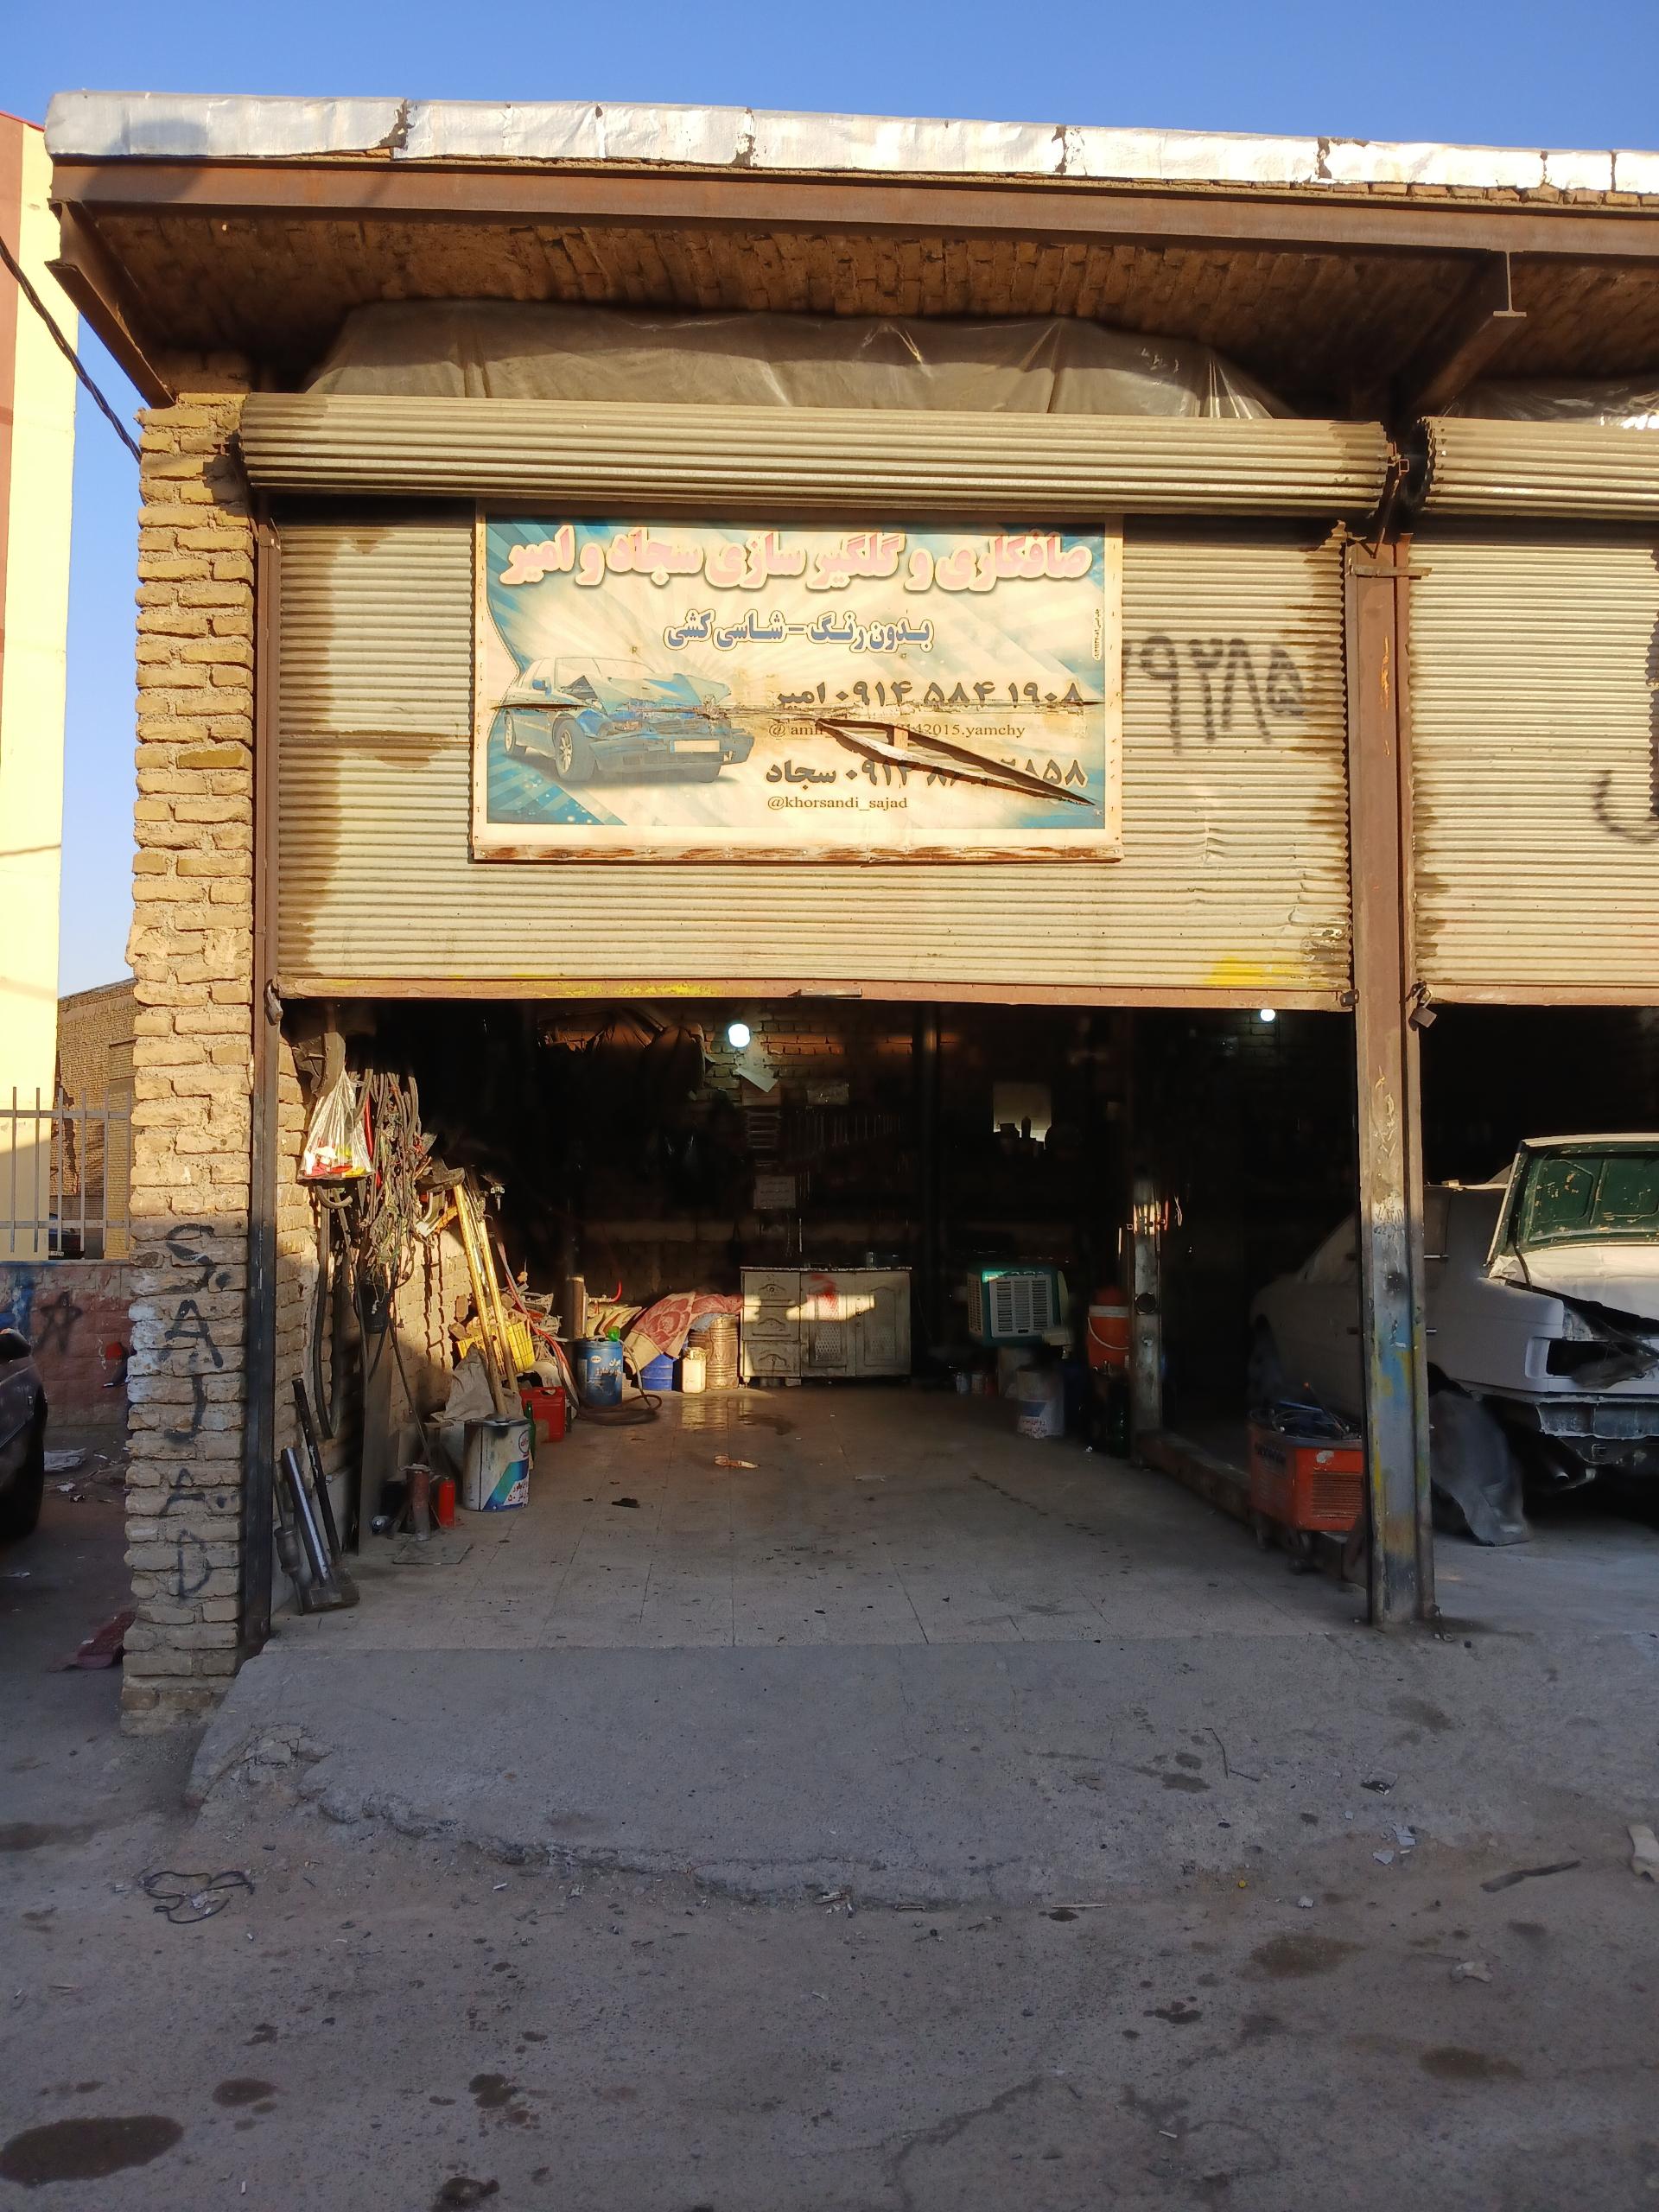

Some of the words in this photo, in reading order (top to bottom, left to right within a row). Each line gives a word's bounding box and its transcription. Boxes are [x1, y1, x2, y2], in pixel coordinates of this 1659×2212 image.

[499, 524, 575, 585] امیر
[575, 543, 605, 585] و
[606, 527, 704, 586] سجاد
[705, 531, 805, 588] سازی
[807, 531, 906, 590] گلگیر
[904, 549, 934, 591] و
[936, 530, 1092, 591] صافکاری
[665, 609, 715, 649] کشی
[715, 610, 785, 650] شاسی
[810, 612, 866, 652] رنگ
[871, 616, 932, 652] بدون
[836, 681, 912, 706] ۰۹۱۴
[924, 682, 995, 707] ۵۸۴
[1008, 682, 1084, 708] ۱۹۰۸
[766, 760, 836, 790] سجاد
[1001, 759, 1085, 785] ۸۵۸
[767, 796, 908, 810] @khorsandi_sajad
